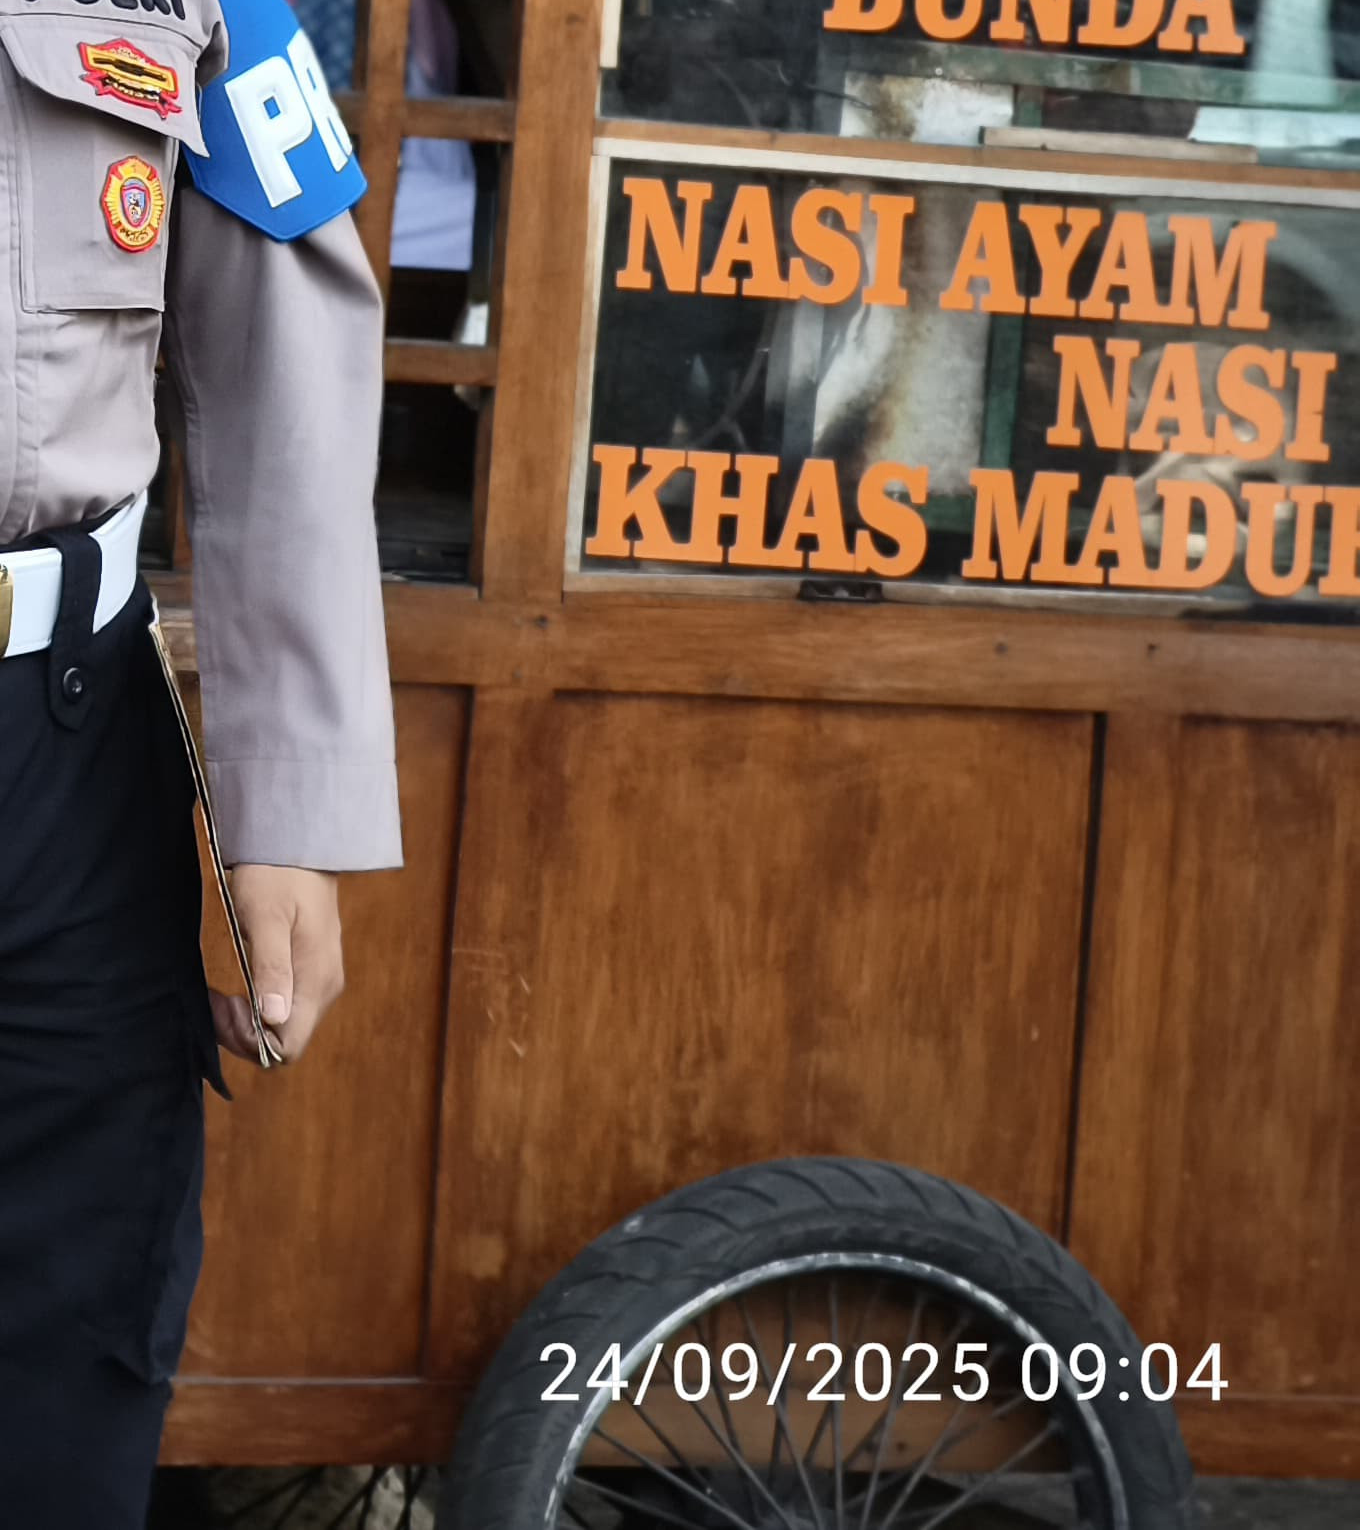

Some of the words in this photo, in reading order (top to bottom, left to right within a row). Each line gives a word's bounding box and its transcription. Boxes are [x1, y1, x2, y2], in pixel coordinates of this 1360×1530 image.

[615, 176, 916, 307] NASI
[938, 200, 1277, 331] AYAM
[1046, 335, 1338, 463] NASI
[585, 444, 929, 577] KHAS
